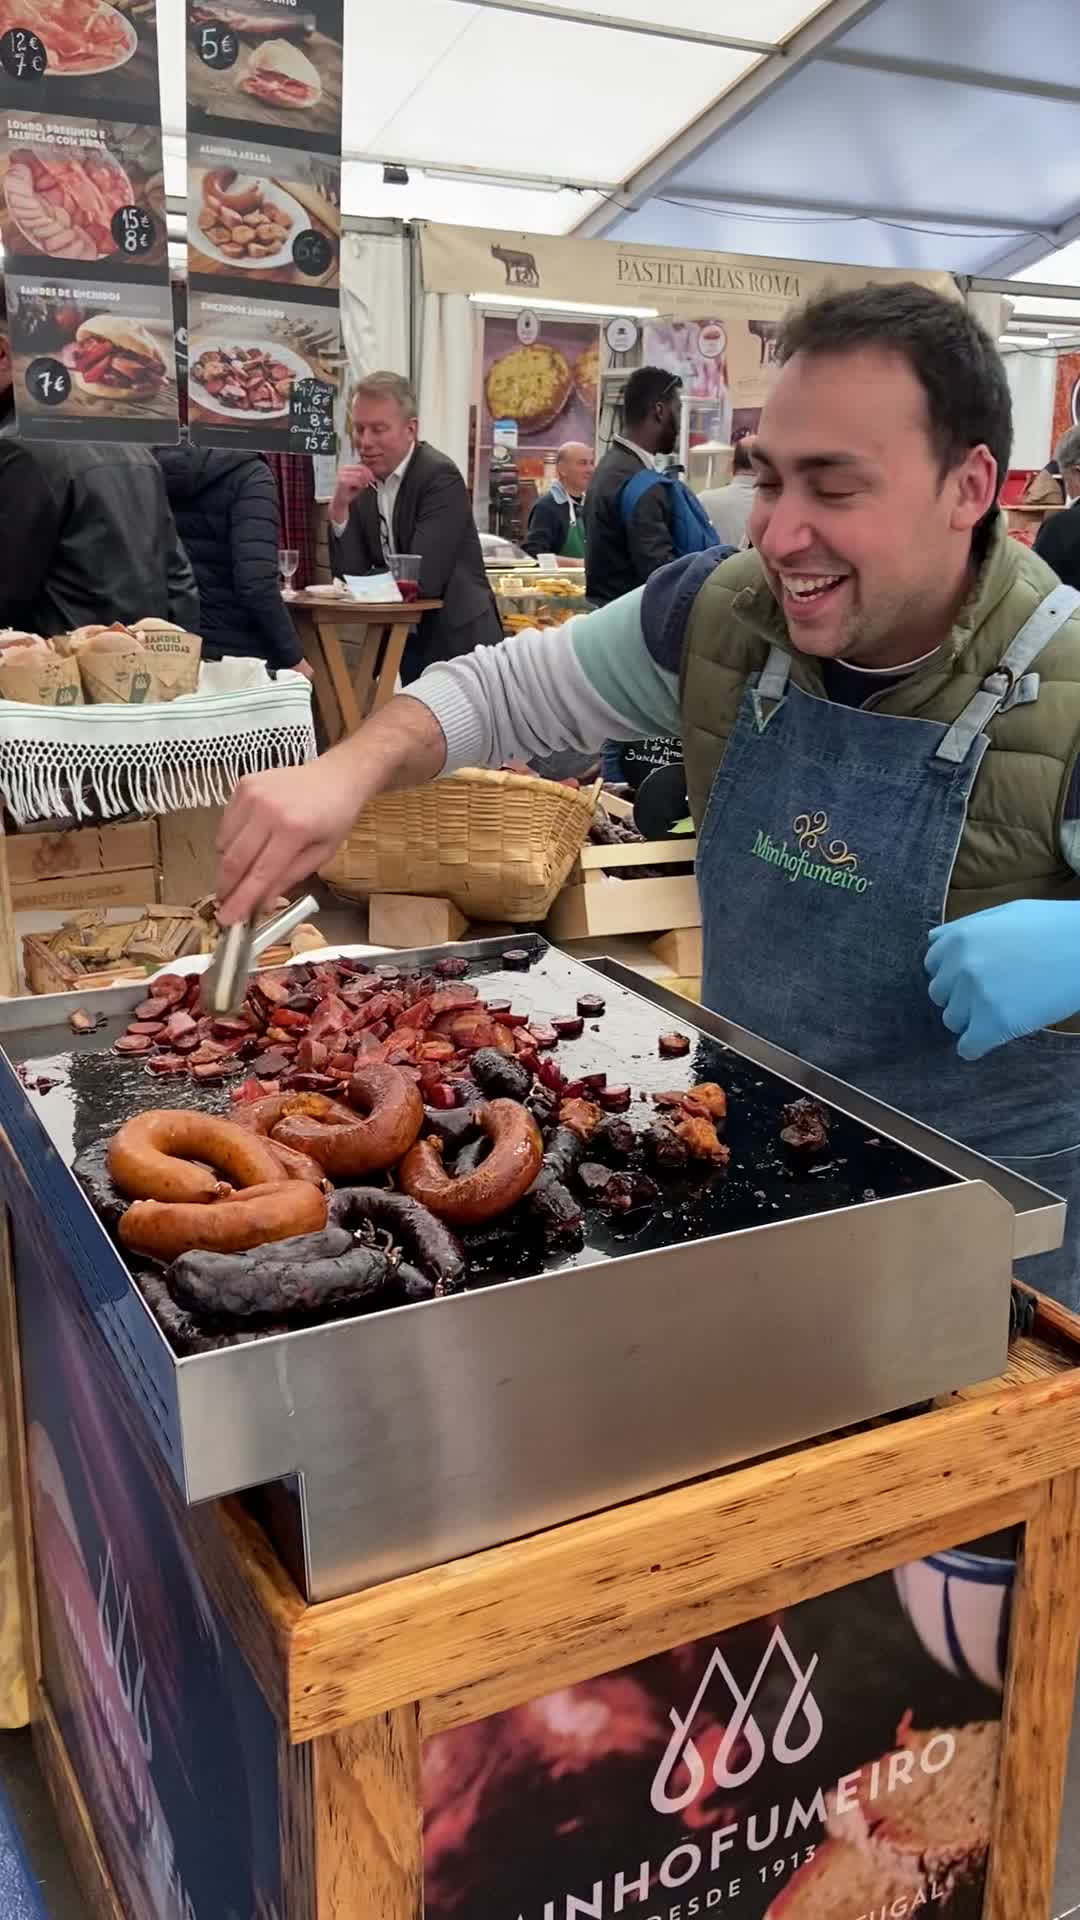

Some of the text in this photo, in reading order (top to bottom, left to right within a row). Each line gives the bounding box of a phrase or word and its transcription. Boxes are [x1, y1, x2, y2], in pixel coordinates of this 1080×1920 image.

[58, 287, 71, 298] DE
[617, 259, 800, 297] PASTELARIAS ROMA
[752, 829, 867, 893] Minhofumeiro
[517, 1733, 957, 1920] NHOFUMEIRO
[646, 1844, 816, 1920] ESDE 1913
